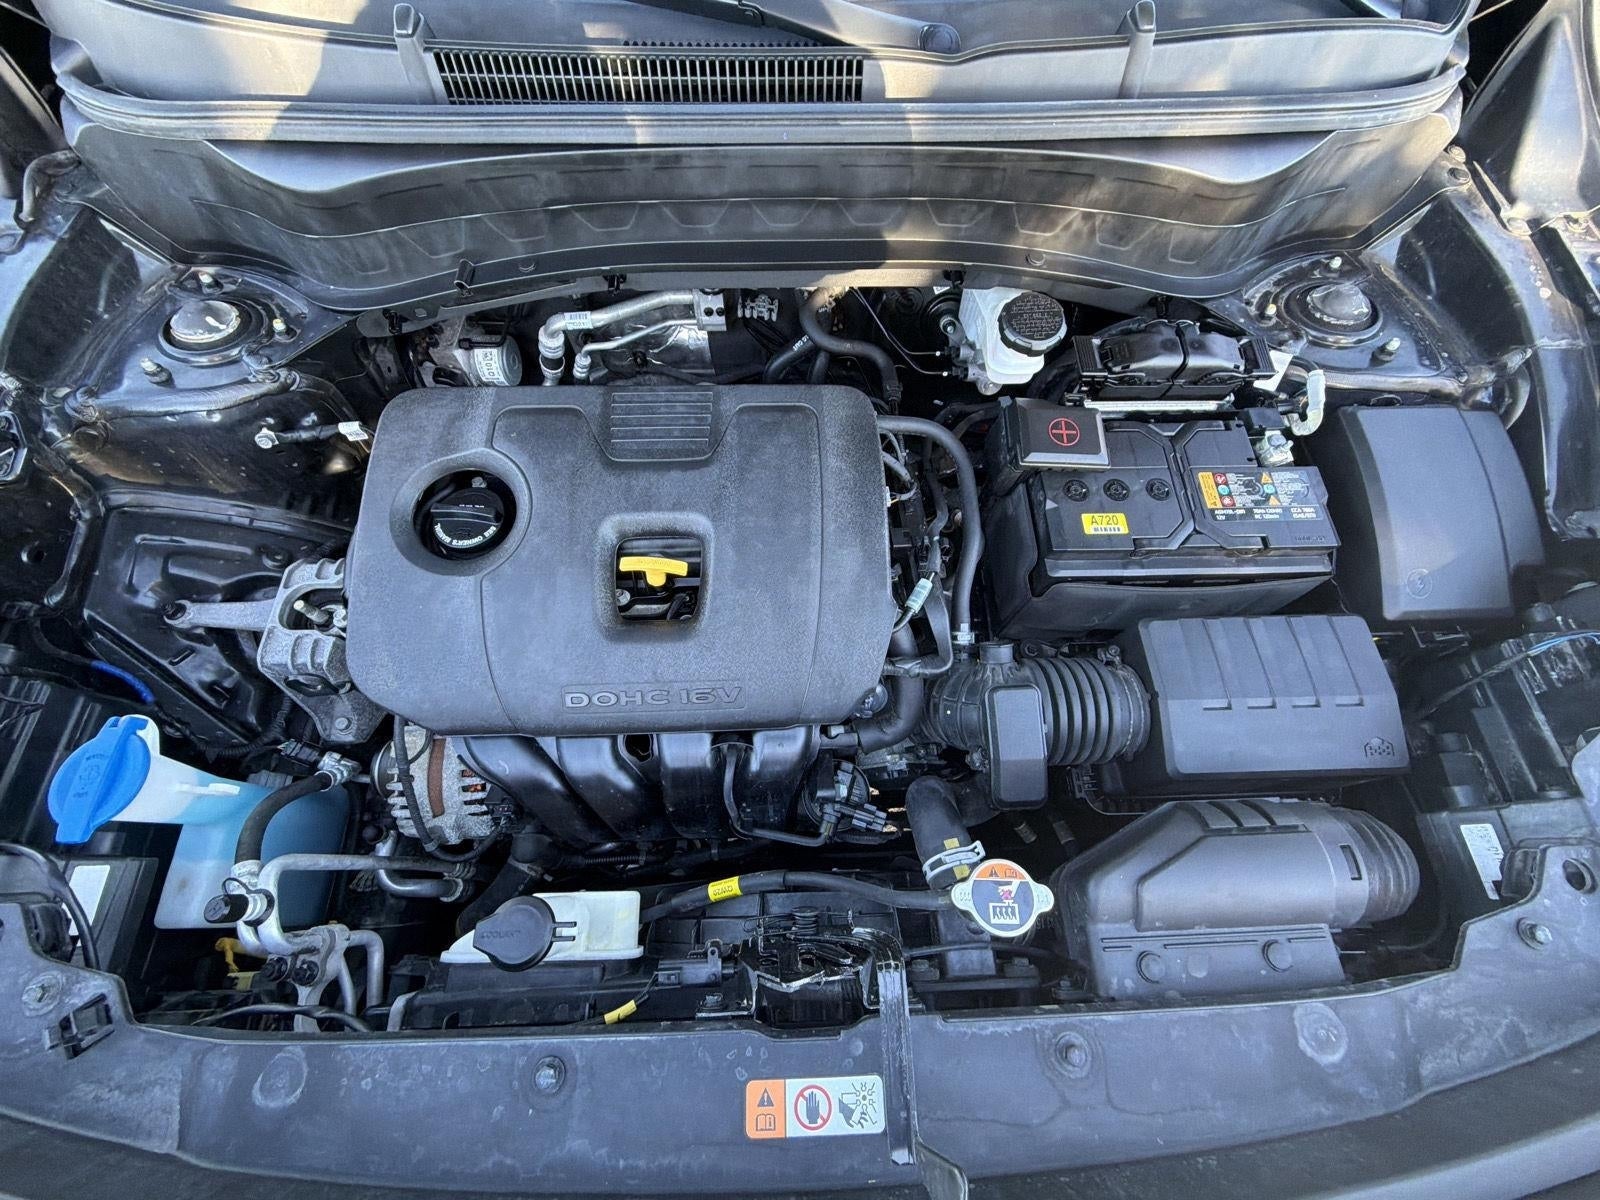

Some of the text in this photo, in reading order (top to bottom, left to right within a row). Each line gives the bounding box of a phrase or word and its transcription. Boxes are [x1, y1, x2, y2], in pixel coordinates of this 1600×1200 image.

[1090, 514, 1119, 526] A720
[433, 522, 497, 546] SEE OWNER'S MANUAL
[564, 686, 742, 709] DOHC 16V
